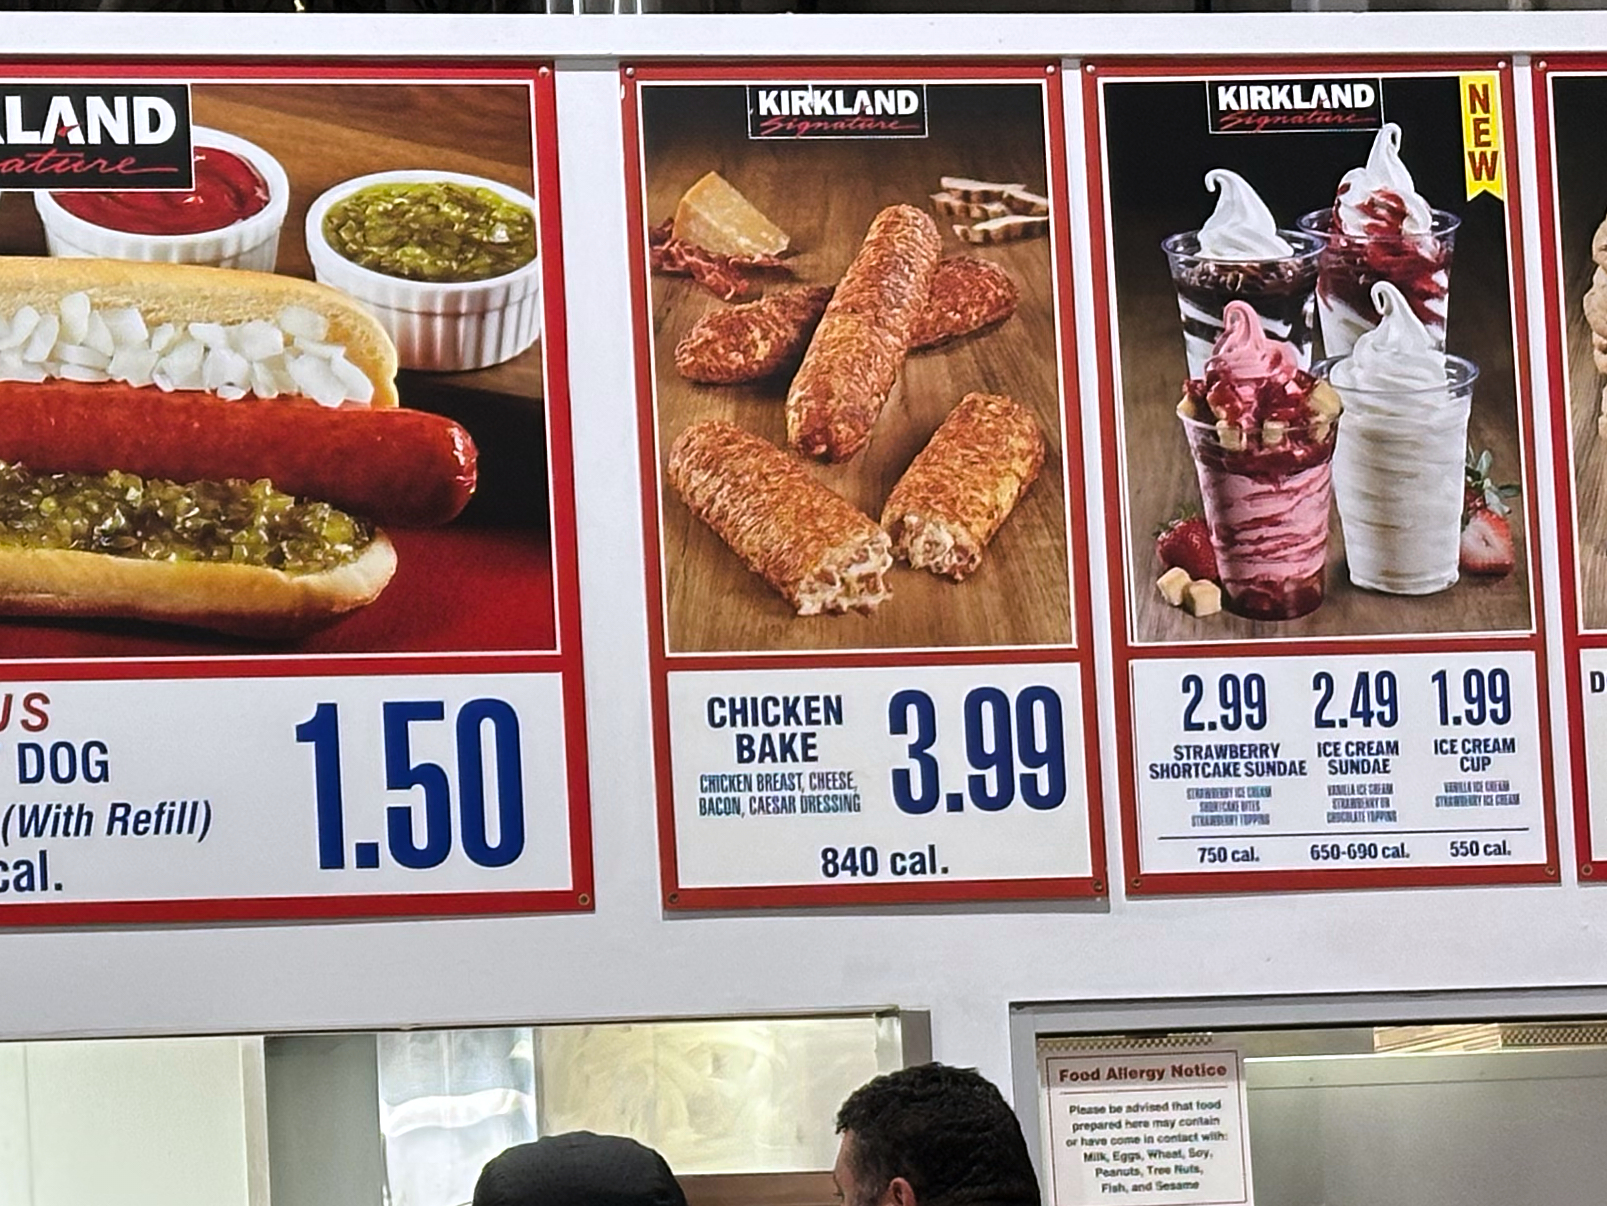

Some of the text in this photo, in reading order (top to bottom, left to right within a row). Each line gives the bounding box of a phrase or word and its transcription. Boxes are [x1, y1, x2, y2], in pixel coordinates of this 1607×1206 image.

[758, 90, 919, 116] KIRKLAND
[1218, 83, 1375, 110] KIRKLAND
[760, 115, 920, 138] Signature
[1219, 109, 1377, 131] Signature
[1468, 83, 1498, 182] NEW
[1181, 673, 1268, 732] 2.99
[1312, 671, 1399, 730] 2.49
[1431, 668, 1511, 727] 1.99
[707, 694, 843, 728] CHICKEN
[735, 731, 819, 764] BAKE
[889, 685, 1067, 815] 3.99
[1173, 743, 1280, 760] STRAWBERRY
[1317, 740, 1399, 758] ICE CREAM
[1434, 738, 1516, 756] ICE CREAM
[17, 741, 109, 785] DOG
[1149, 760, 1307, 780] SHORTCAKE SUNDAE
[1328, 759, 1392, 775] SUNDAE
[1460, 757, 1492, 773] CUP
[296, 698, 525, 869] 1.50
[700, 771, 858, 793] CHICKEN BREAST, CHEESE,
[699, 794, 861, 818] BACON, CAESAR DRESSING
[2, 802, 93, 847] (With
[106, 800, 212, 843] Refill)
[1197, 845, 1260, 864] 750 cal.
[1310, 843, 1410, 861] 650-690 cal.
[1450, 839, 1511, 858] 550 cal.
[821, 844, 949, 878] 840 cal.
[1059, 1063, 1227, 1082] Food Allergy Notice
[1069, 1100, 1221, 1115] Please be advised that food
[1072, 1116, 1220, 1133] prepared here may contain
[1066, 1138, 1077, 1147] or
[1081, 1136, 1107, 1146] have
[1110, 1136, 1140, 1145] come
[1144, 1134, 1154, 1144] in
[1157, 1133, 1198, 1143] contact
[1084, 1152, 1110, 1164] Milk,
[1113, 1151, 1144, 1163] Eggs,
[1147, 1149, 1186, 1161] Wheat,
[1095, 1164, 1203, 1178] Peanuts, Tree Nuts,
[1102, 1180, 1199, 1194] Fish, and Sesame
